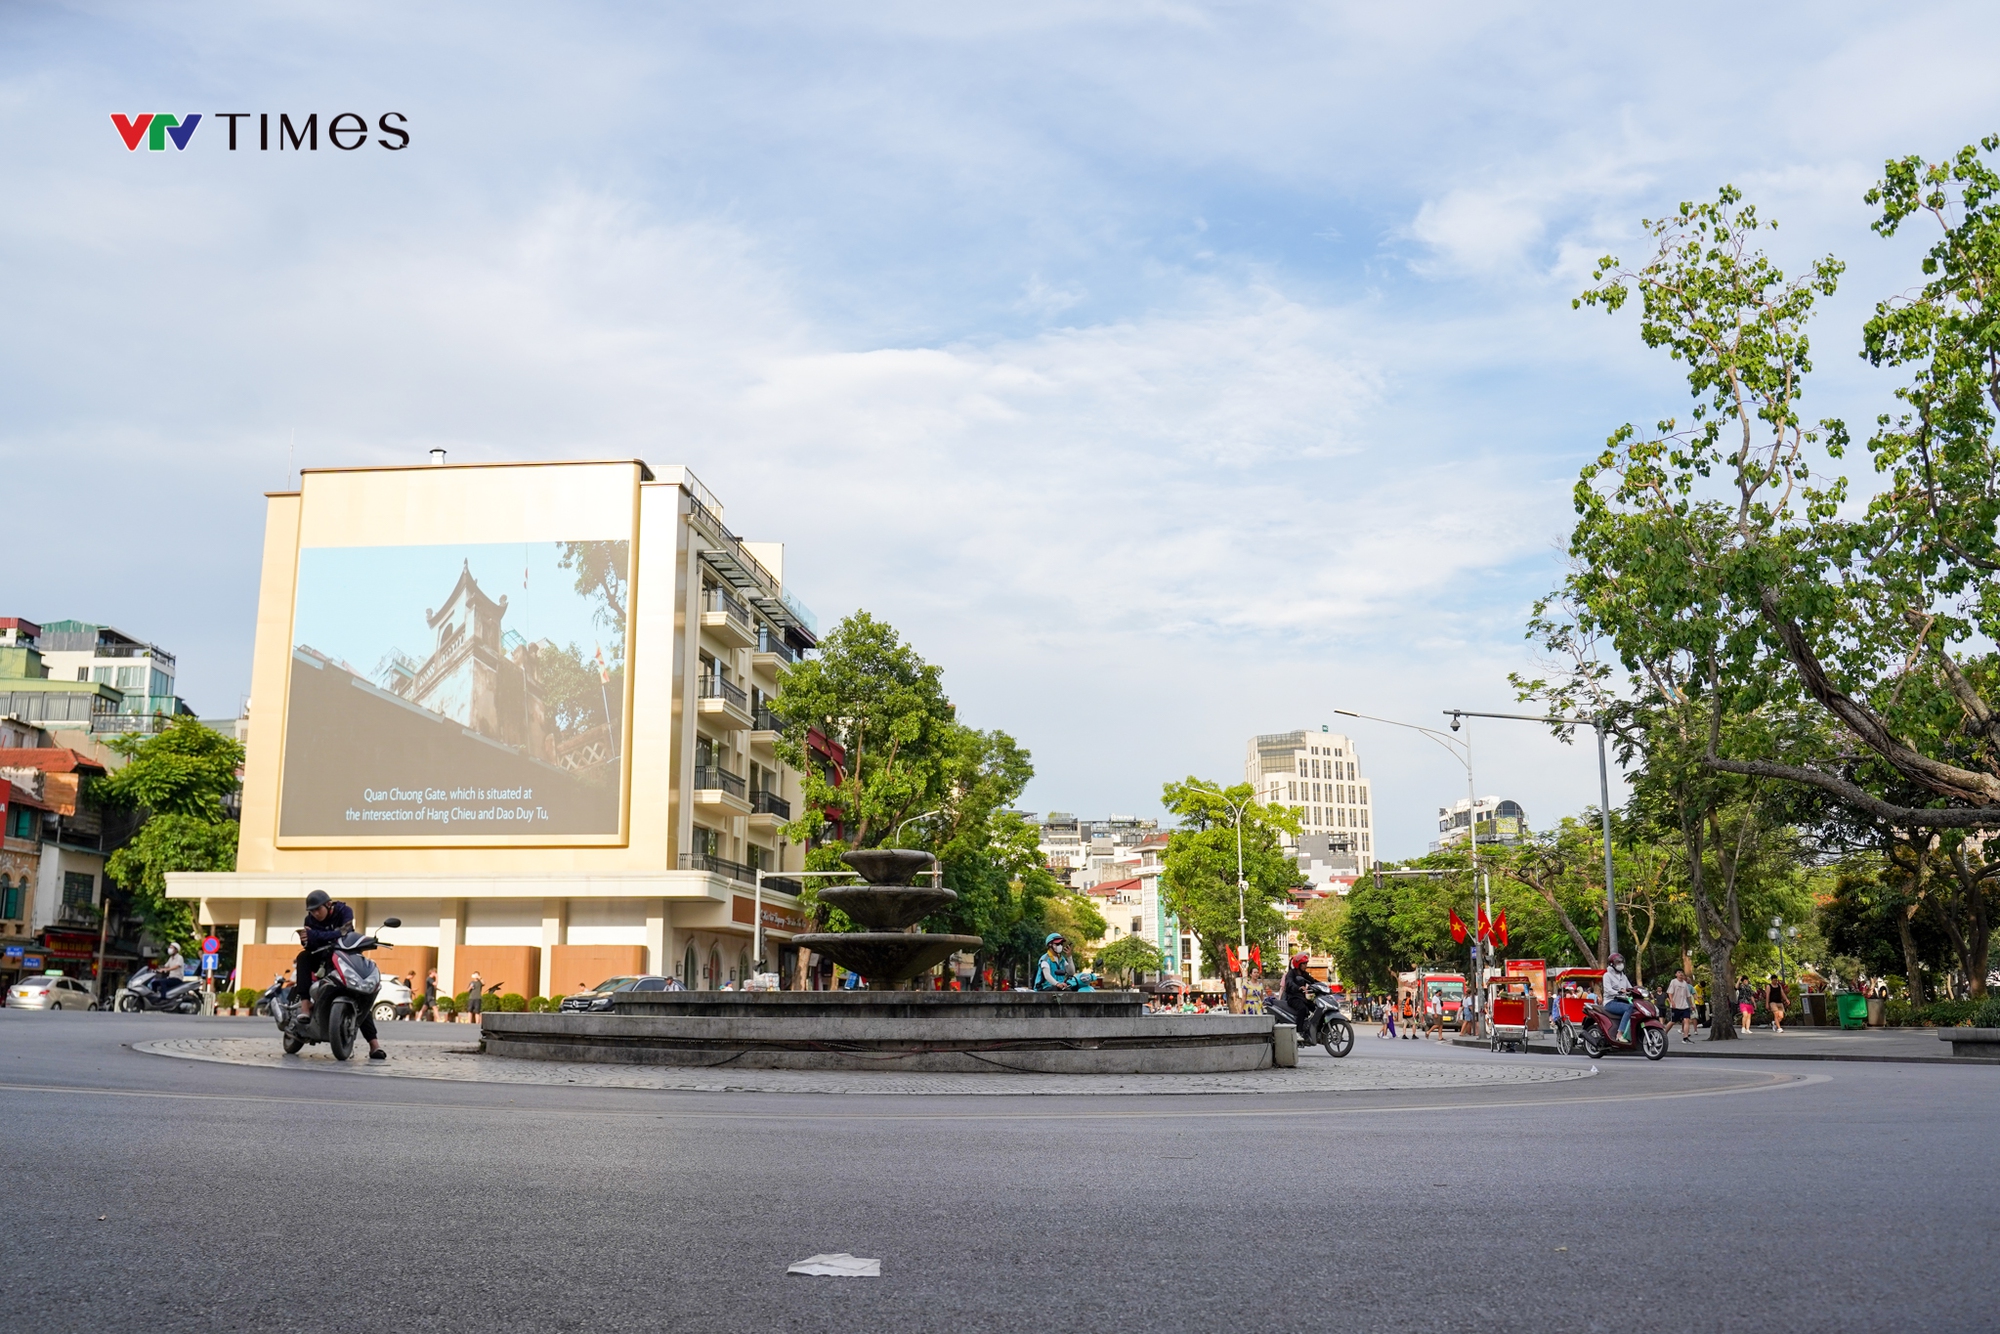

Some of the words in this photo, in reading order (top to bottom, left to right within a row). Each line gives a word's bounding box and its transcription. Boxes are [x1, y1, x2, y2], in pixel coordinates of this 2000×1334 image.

[363, 787, 388, 803] Quan
[389, 787, 423, 804] Chuong
[424, 787, 447, 801] Gate,
[449, 786, 476, 800] which
[477, 787, 485, 800] is
[486, 785, 522, 800] situated
[523, 788, 533, 800] at
[345, 807, 361, 821] the
[362, 808, 413, 821] intersection
[415, 806, 426, 820] of
[427, 807, 450, 824] Hang
[450, 806, 477, 820] Chieu
[477, 806, 495, 820] and
[496, 807, 515, 820] Dao
[516, 806, 534, 823] Duy
[536, 806, 549, 821] Tu,
